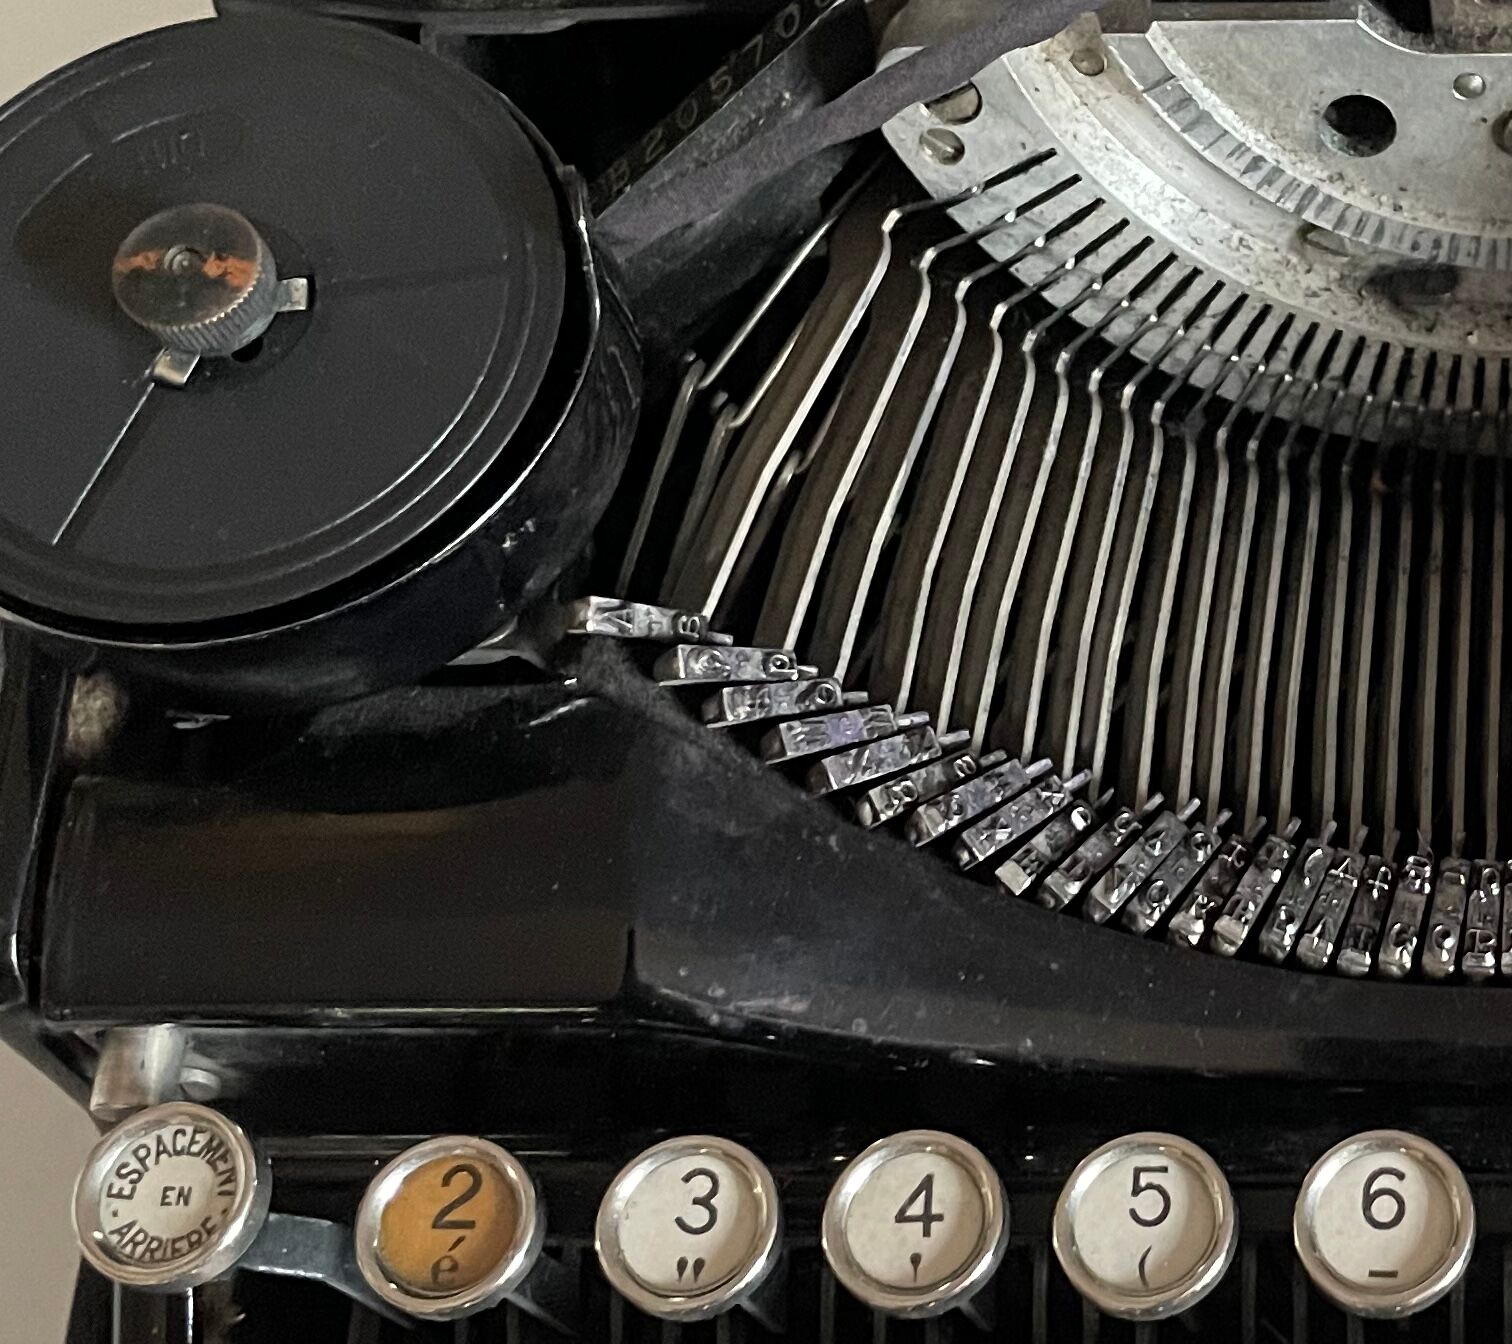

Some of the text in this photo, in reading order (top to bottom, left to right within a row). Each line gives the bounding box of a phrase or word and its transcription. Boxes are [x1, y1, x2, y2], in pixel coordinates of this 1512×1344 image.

[106, 1124, 238, 1201] ESPACEMENT
[160, 1185, 193, 1207] EN
[432, 1164, 482, 1229] 2
[675, 1168, 719, 1235] 3
[895, 1174, 944, 1237] 4
[1129, 1166, 1171, 1227] 5
[1362, 1168, 1405, 1230] 6
[430, 1235, 465, 1286] é
